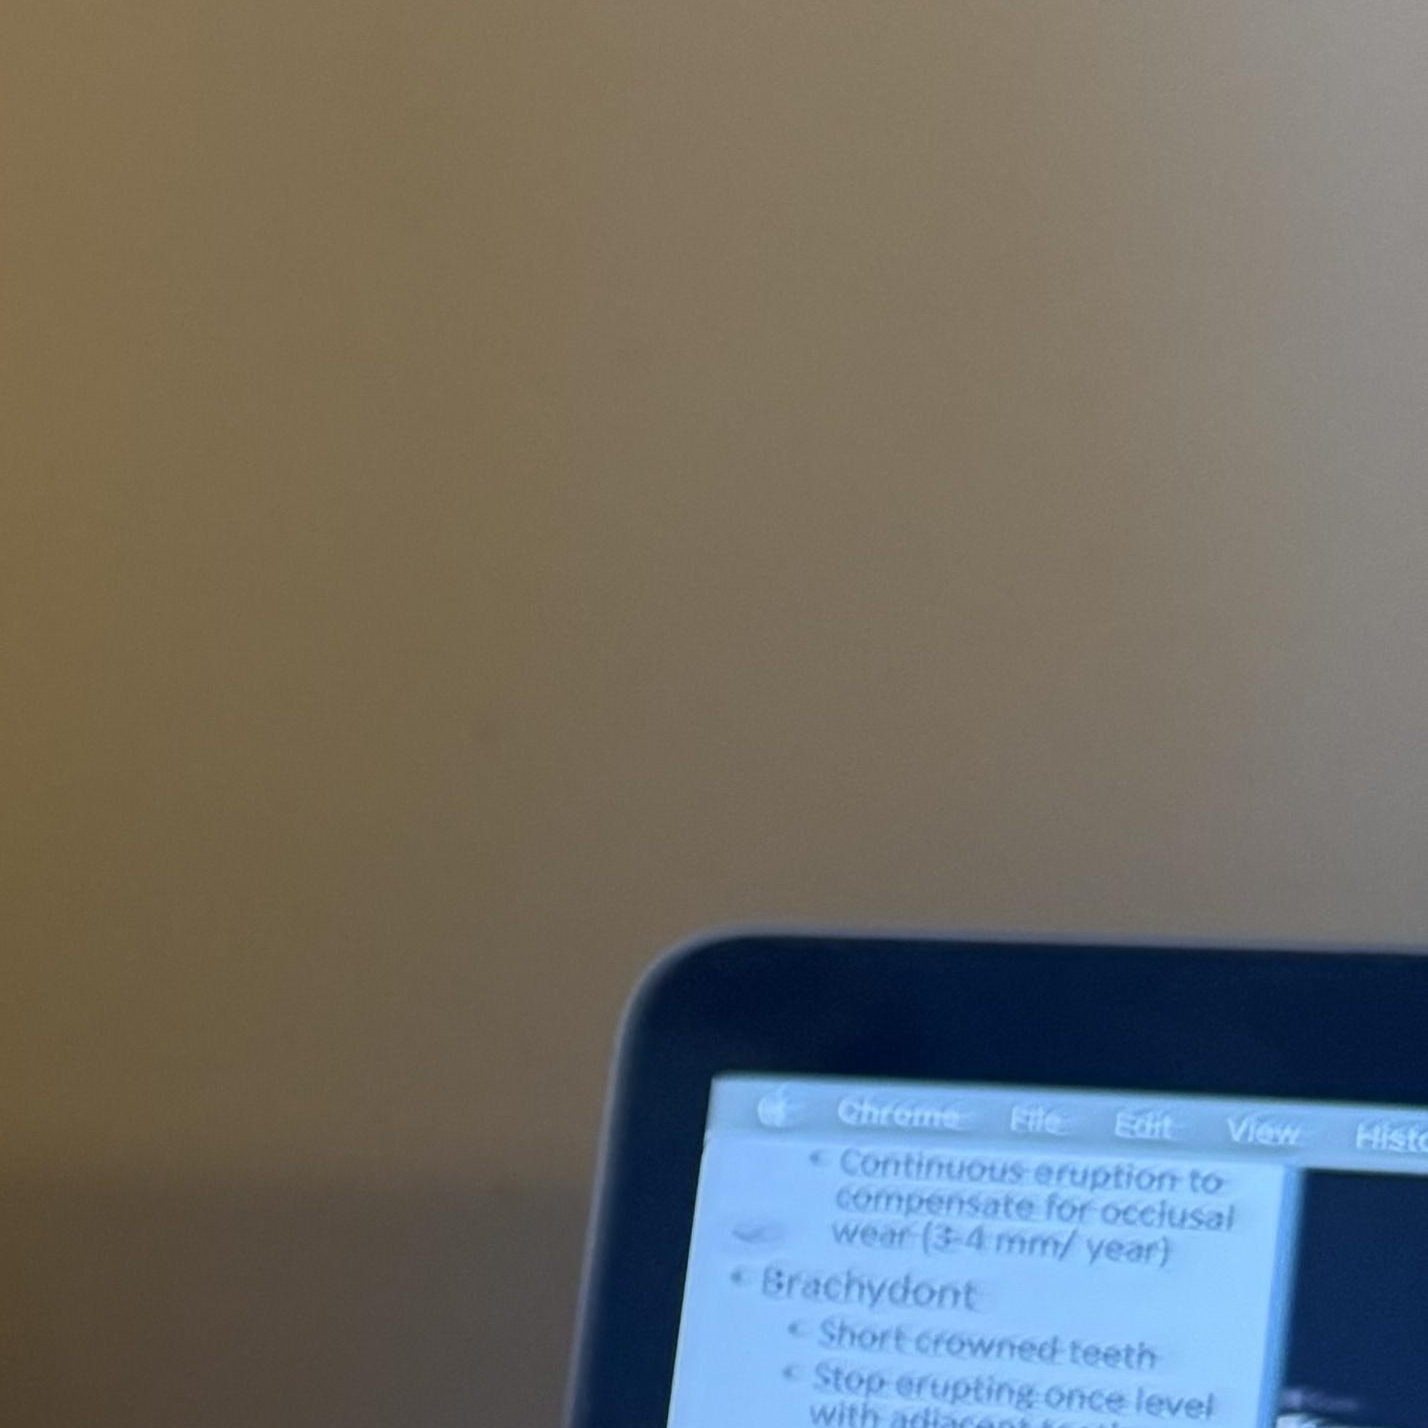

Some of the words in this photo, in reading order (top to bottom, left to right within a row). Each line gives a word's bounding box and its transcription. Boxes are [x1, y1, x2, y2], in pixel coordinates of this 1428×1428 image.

[837, 1097, 962, 1131] Chrome
[1010, 1104, 1064, 1135] File
[1114, 1109, 1174, 1141] Edit
[1226, 1115, 1302, 1147] View
[840, 1148, 1024, 1185] Continuous
[1034, 1159, 1178, 1193] eruption
[1188, 1168, 1225, 1195] to
[836, 1185, 1035, 1220] compensate
[1046, 1190, 1089, 1223] for
[1100, 1197, 1236, 1232] occlusal
[831, 1222, 907, 1249] wear
[921, 1221, 987, 1256] (3-4
[996, 1228, 1078, 1261] mm/
[1086, 1235, 1170, 1267] year)
[761, 1266, 978, 1310] Brachydont
[817, 1315, 906, 1353] Short
[914, 1332, 1060, 1364] crowned
[1069, 1338, 1158, 1370] teeth
[812, 1361, 886, 1398] Stop
[895, 1373, 1037, 1410] erupting
[1044, 1383, 1126, 1414] once
[1135, 1385, 1216, 1421] level
